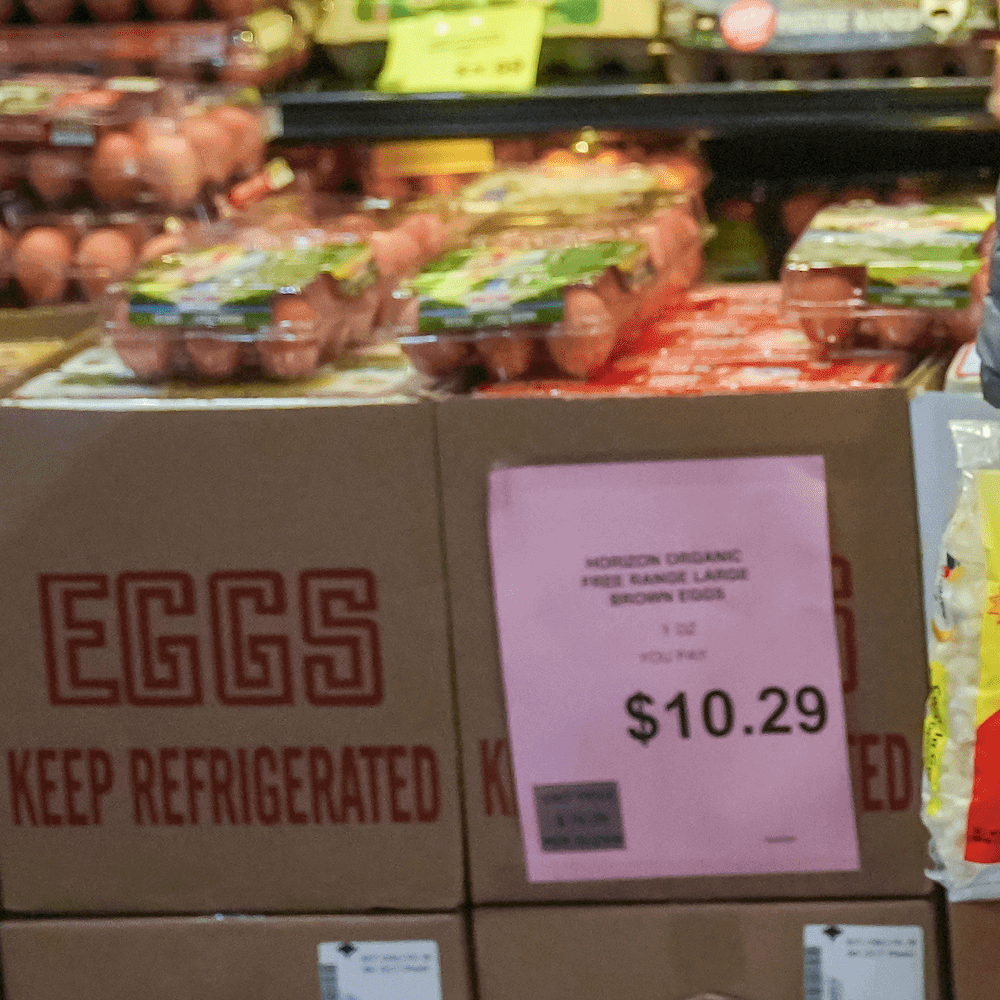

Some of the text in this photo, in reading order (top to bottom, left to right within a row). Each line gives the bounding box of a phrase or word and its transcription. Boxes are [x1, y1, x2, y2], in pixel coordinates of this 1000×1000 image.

[580, 567, 748, 589] FREE RANGE LARGE
[585, 549, 742, 569] HORIZON ORGANIC
[609, 586, 726, 606] BROWN EGGS
[37, 567, 386, 707] EGGS
[625, 685, 829, 748] $10.29
[7, 747, 115, 828] KEEP
[127, 745, 443, 828] REFRIGERATED
